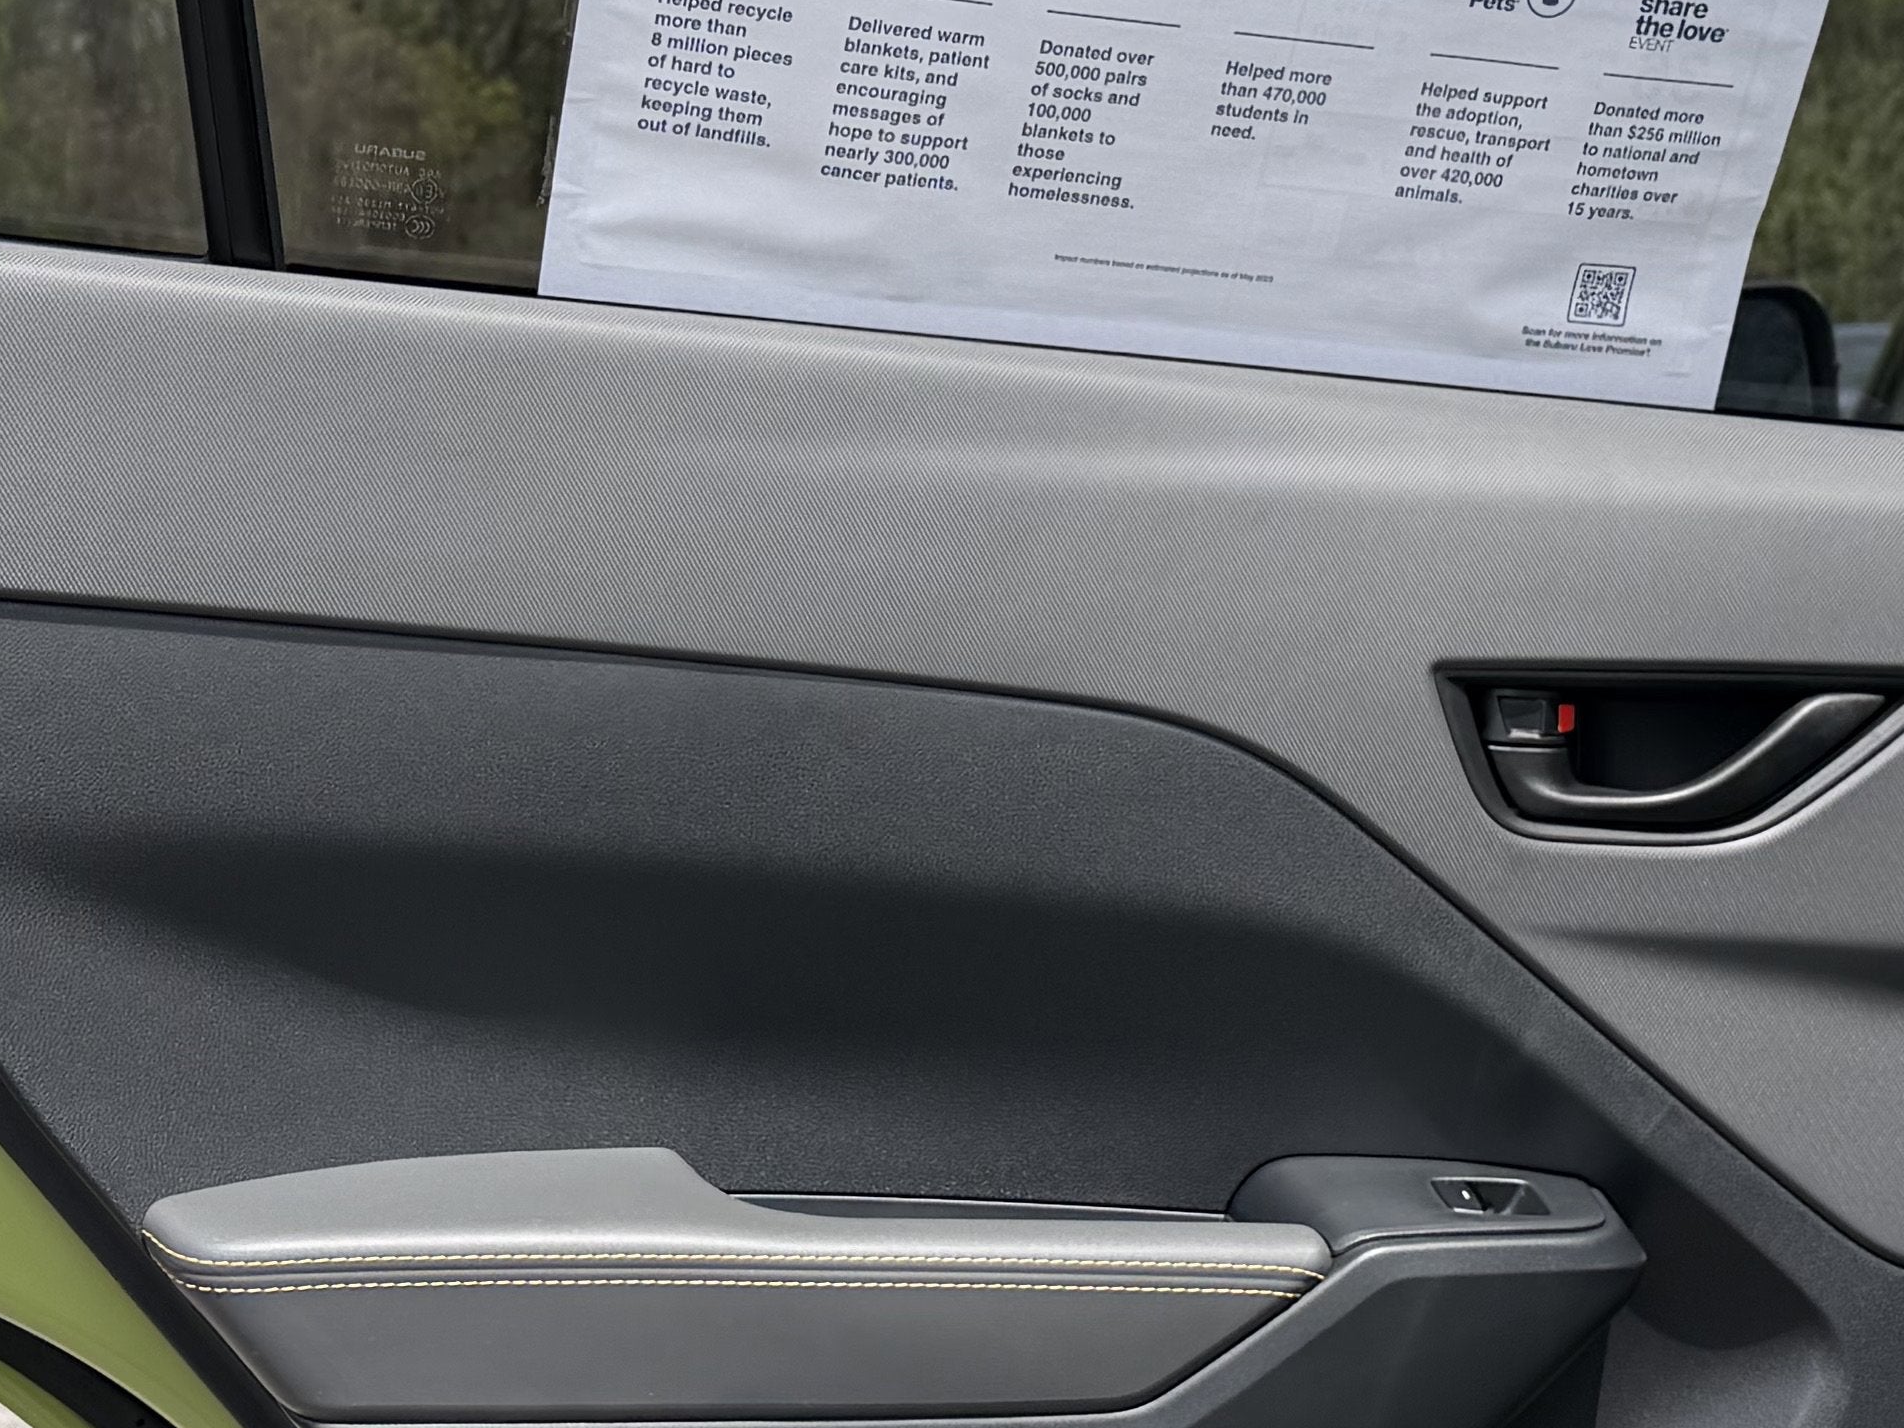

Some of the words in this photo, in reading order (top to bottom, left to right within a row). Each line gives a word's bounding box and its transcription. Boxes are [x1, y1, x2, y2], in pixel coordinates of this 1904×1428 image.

[728, 2, 793, 22] recycle
[654, 13, 701, 30] more
[707, 19, 747, 37] than
[848, 16, 932, 40] Delivered
[938, 30, 985, 46] warm
[1635, 16, 1673, 38] the
[651, 32, 662, 46] 8
[667, 36, 728, 55] million
[734, 45, 793, 66] pieces
[844, 37, 923, 63] blankets,
[928, 51, 989, 69] patient
[1039, 39, 1112, 61] Donated
[1117, 51, 1155, 65] over
[1629, 36, 1675, 53] EVENT
[648, 55, 667, 68] of
[671, 56, 712, 75] hard
[718, 64, 735, 78] to
[840, 62, 878, 76] care
[884, 64, 920, 84] kits,
[925, 72, 958, 86] and
[1035, 61, 1100, 81] 500,000
[1104, 71, 1147, 86] pairs
[1225, 61, 1285, 80] Helped
[1289, 71, 1332, 85] more
[644, 77, 709, 97] recycle
[715, 87, 771, 109] waste,
[836, 82, 947, 110] encouraging
[1031, 83, 1049, 96] of
[1052, 87, 1103, 102] socks
[1108, 93, 1140, 106] and
[1221, 82, 1257, 99] than
[1263, 86, 1326, 106] 470,000
[1421, 82, 1479, 102] Helped
[1483, 92, 1548, 110] support
[641, 95, 712, 121] keeping
[718, 107, 762, 126] them
[832, 104, 921, 125] messages
[927, 113, 945, 126] of
[1028, 103, 1091, 122] 100,000
[1216, 103, 1288, 122] students
[1293, 110, 1309, 124] in
[1416, 103, 1441, 118] the
[1446, 107, 1523, 131] adoption,
[1594, 101, 1660, 120] Donated
[1664, 112, 1704, 124] more
[637, 118, 667, 133] out
[672, 122, 691, 136] of
[695, 124, 770, 147] landfills.
[828, 122, 873, 141] hope
[878, 129, 895, 142] to
[900, 133, 968, 150] support
[1021, 123, 1093, 143] blankets
[1099, 131, 1115, 145] to
[1211, 125, 1256, 140] need.
[1410, 125, 1469, 145] rescue,
[1475, 131, 1550, 152] transport
[1588, 122, 1623, 138] than
[1668, 130, 1721, 146] million
[824, 145, 879, 165] nearly
[884, 150, 949, 169] 300,000
[1017, 144, 1065, 160] those
[1405, 145, 1436, 159] and
[1440, 146, 1491, 166] health
[1496, 154, 1514, 168] of
[1583, 142, 1598, 156] to
[1602, 146, 1666, 162] national
[1669, 152, 1700, 164] and
[820, 165, 881, 182] cancer
[884, 173, 958, 191] patients.
[1012, 165, 1122, 190] experiencing
[1400, 165, 1437, 180] over
[1441, 168, 1503, 187] 420,000
[1577, 162, 1658, 182] hometown
[1008, 182, 1134, 209] homelessness.
[1395, 185, 1463, 204] animals.
[1571, 183, 1638, 200] charities
[1643, 190, 1678, 203] over
[1568, 202, 1584, 216] 15
[1587, 207, 1633, 220] years.
